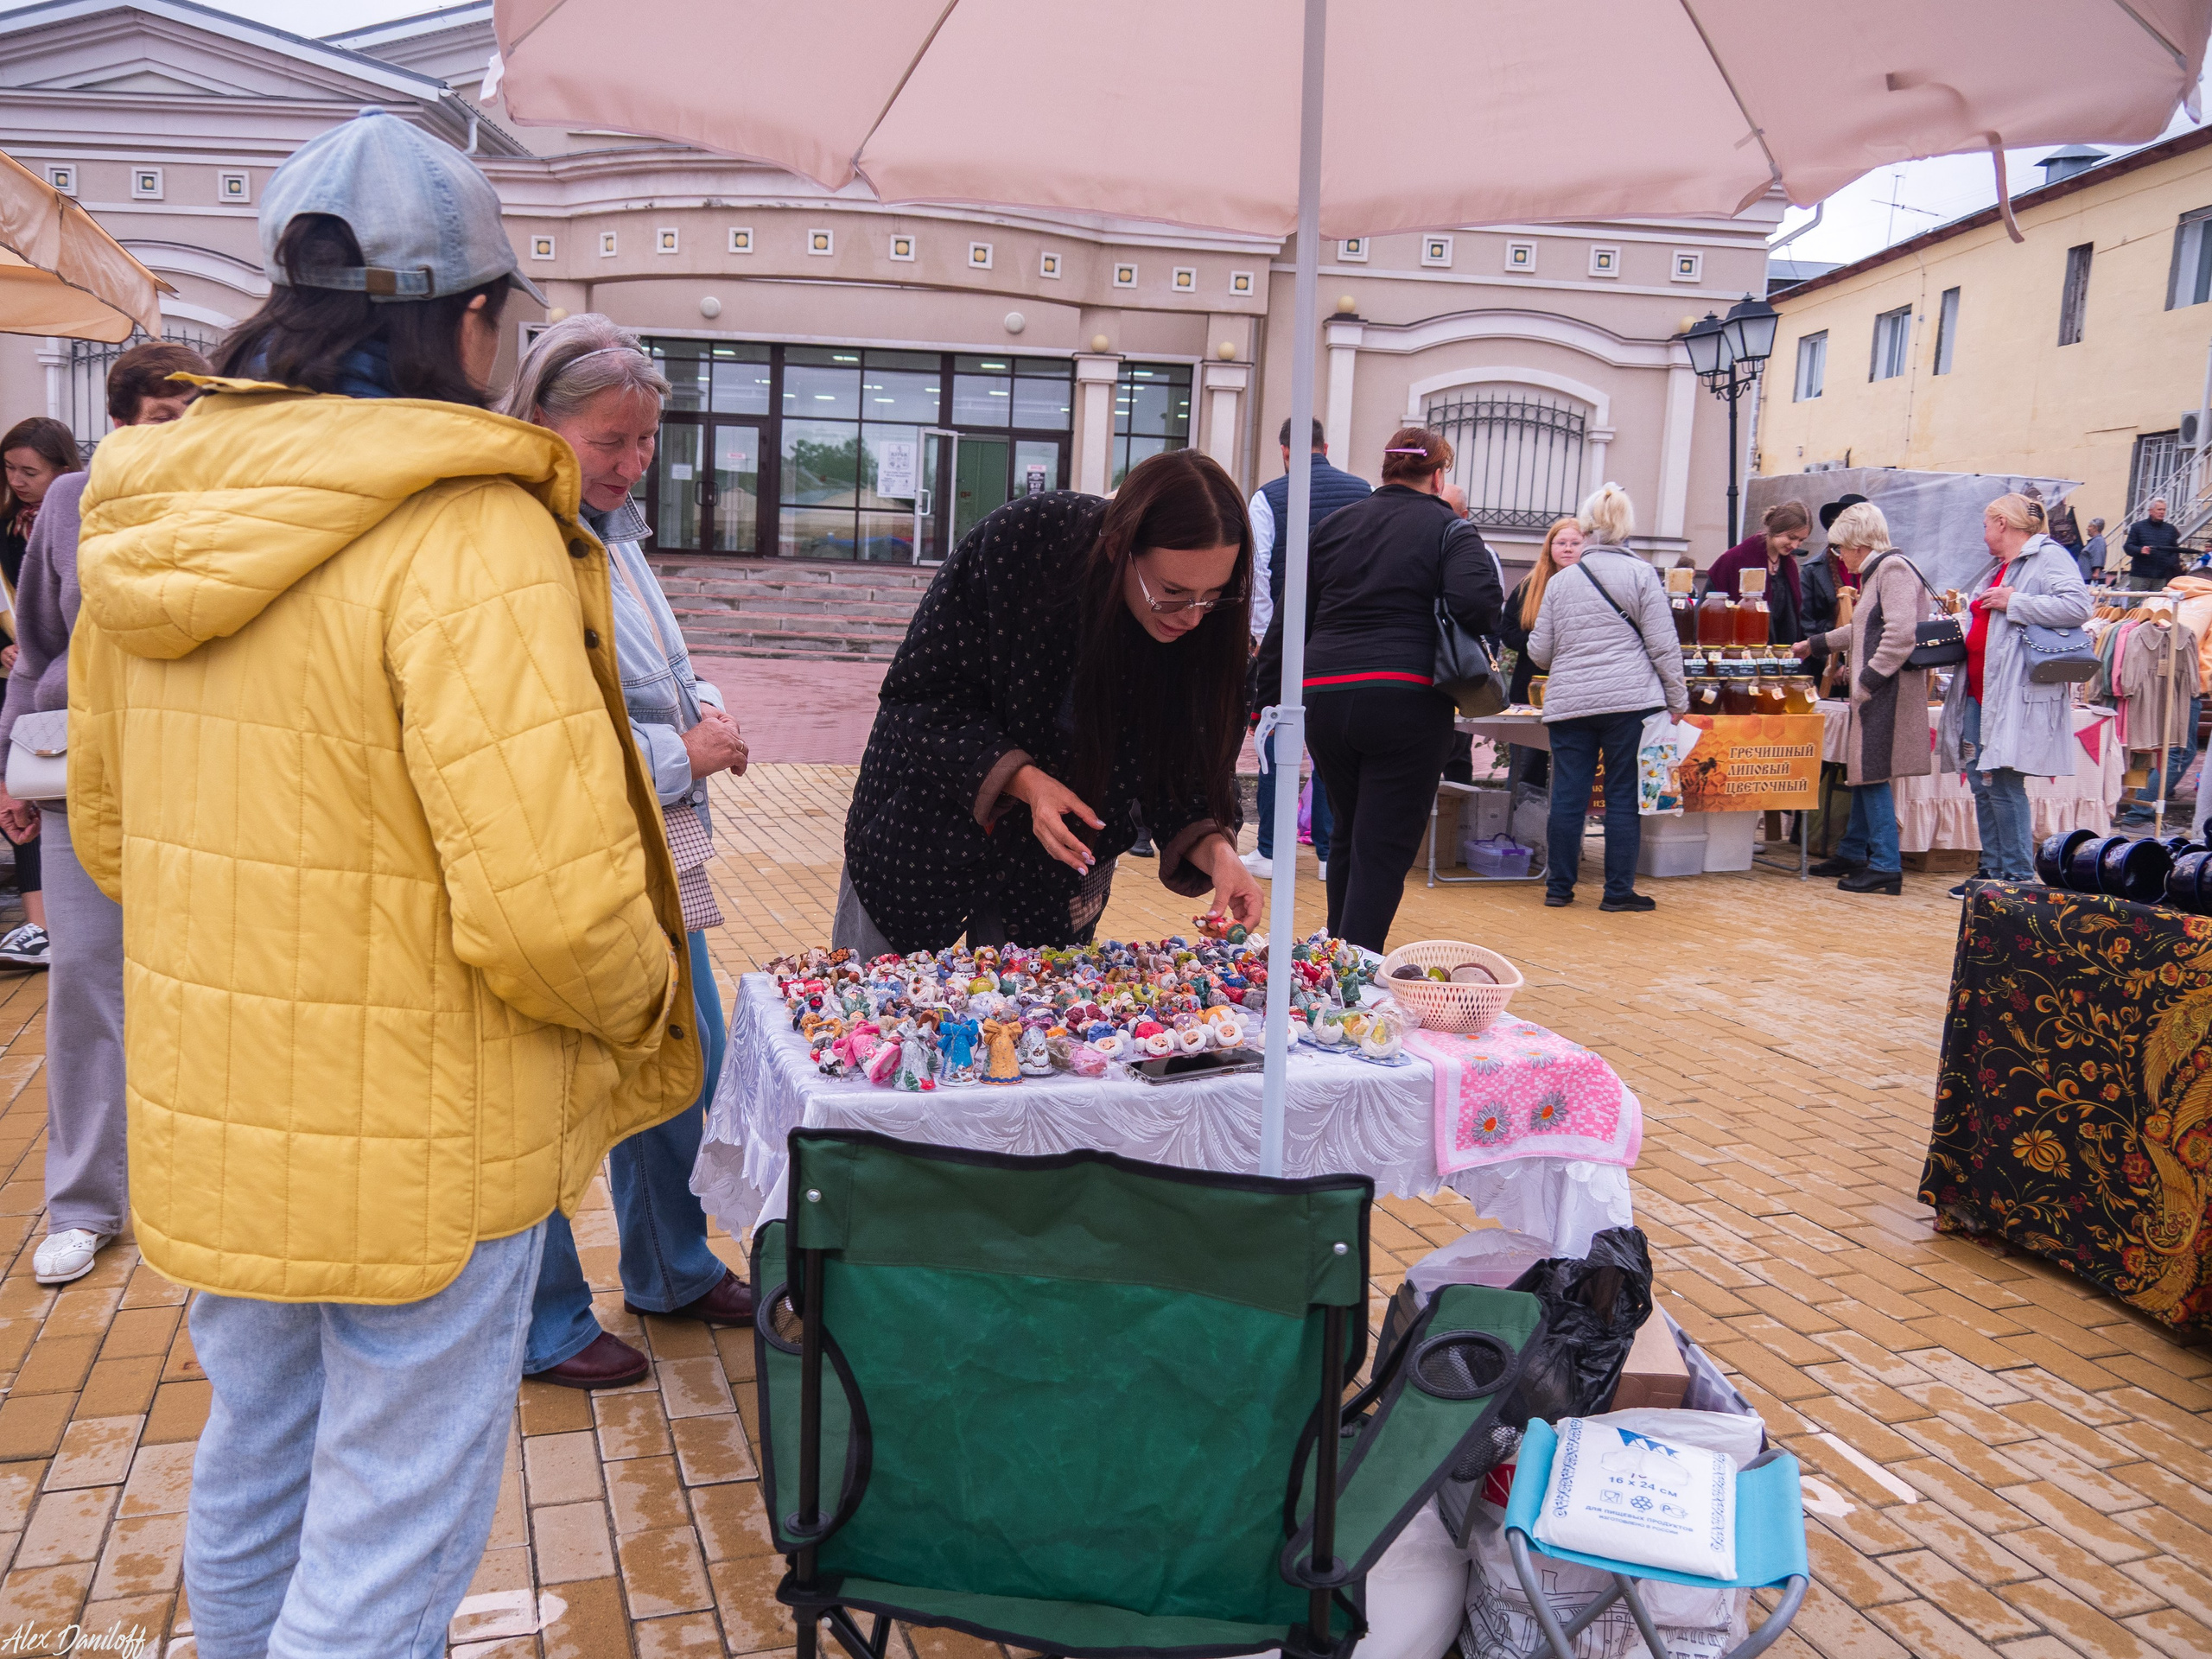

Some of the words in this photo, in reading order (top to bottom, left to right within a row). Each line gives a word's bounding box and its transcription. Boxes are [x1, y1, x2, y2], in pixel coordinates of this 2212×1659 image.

[1729, 743, 1814, 759] ГРЕЧИШНЫЙ
[1727, 761, 1789, 775] ЛИПОВЫЙ
[1726, 779, 1808, 795] ЦВЕТОЧНЫЙ
[1640, 1481, 1656, 1491] 24
[1647, 1517, 1694, 1532] ПРОДУКТОВ
